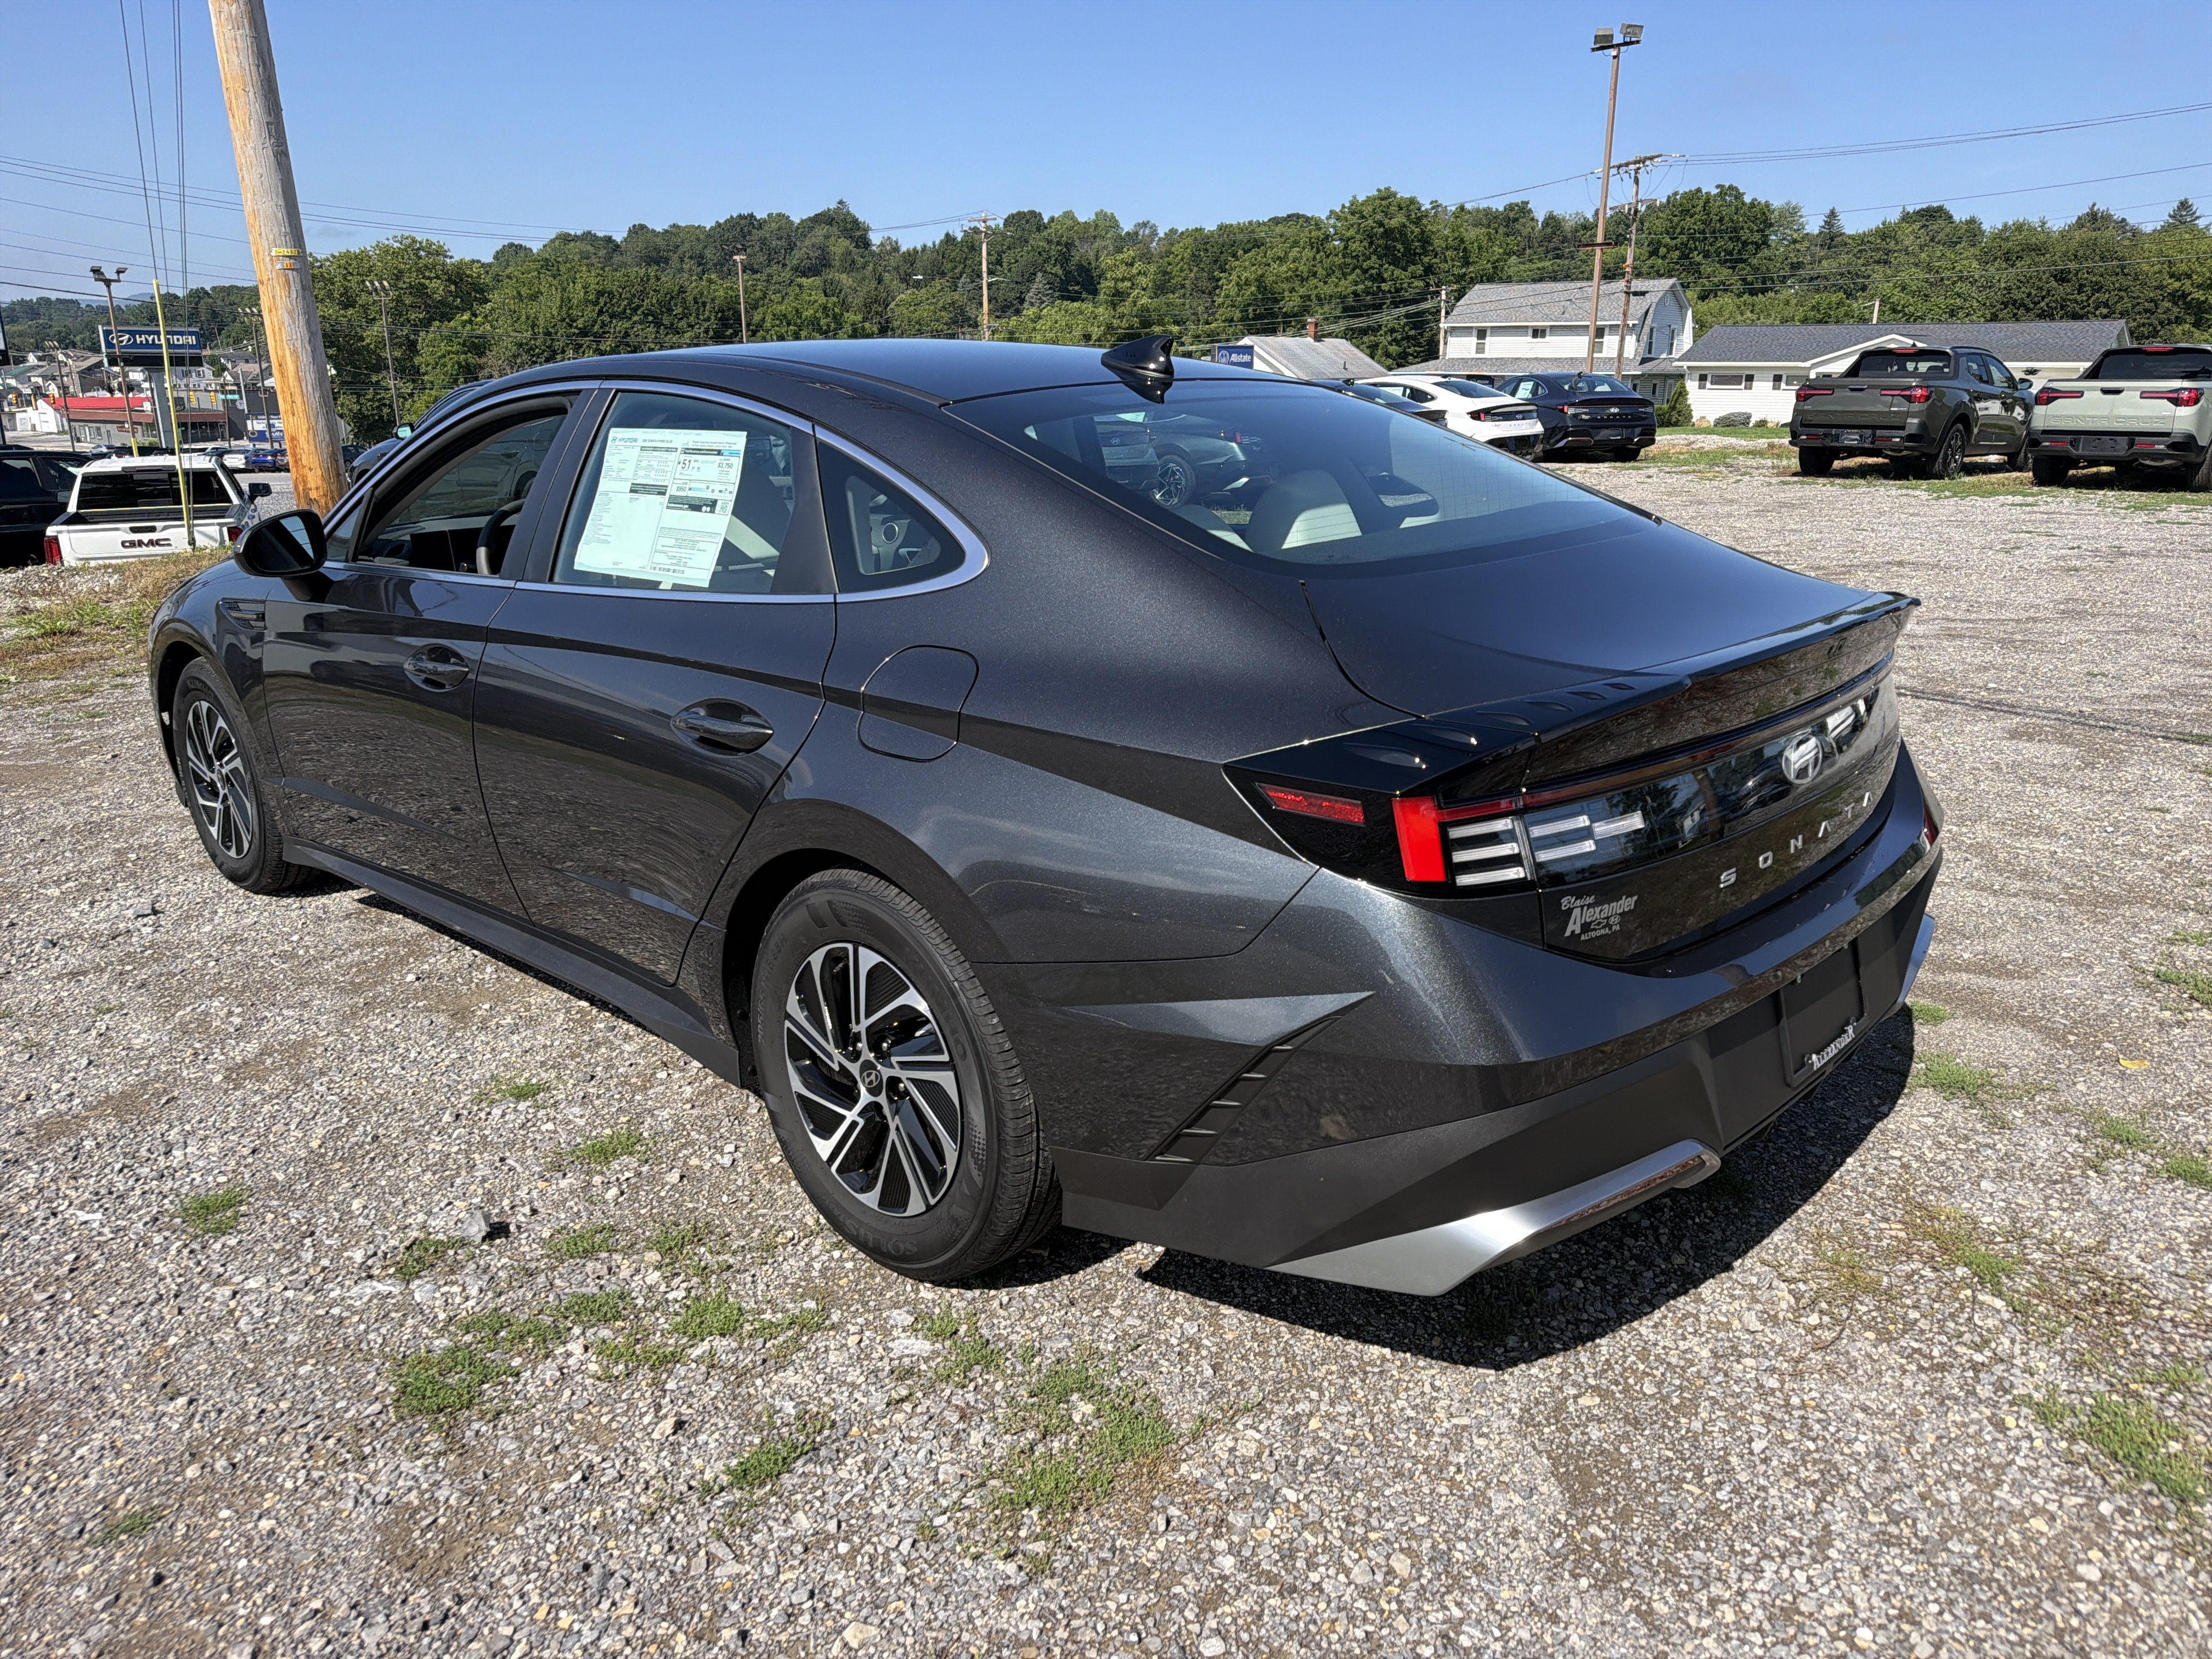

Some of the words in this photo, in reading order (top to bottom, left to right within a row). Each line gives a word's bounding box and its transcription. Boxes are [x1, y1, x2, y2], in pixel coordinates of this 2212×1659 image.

[136, 335, 196, 345] HYUNDAI
[1229, 353, 1251, 363] Allstate
[2051, 416, 2109, 426] SANTA
[2113, 417, 2165, 426] CRUZ
[681, 459, 692, 470] 51
[121, 538, 173, 549] GMC
[1719, 791, 1873, 888] SONATA
[1561, 895, 1595, 910] Blaise
[1564, 895, 1638, 937] Alexander
[1580, 927, 1611, 941] ALTOONA,
[1612, 923, 1621, 932] PA
[1812, 1024, 1855, 1071] ALEXANDER
[843, 1216, 919, 1256] SOLUS
